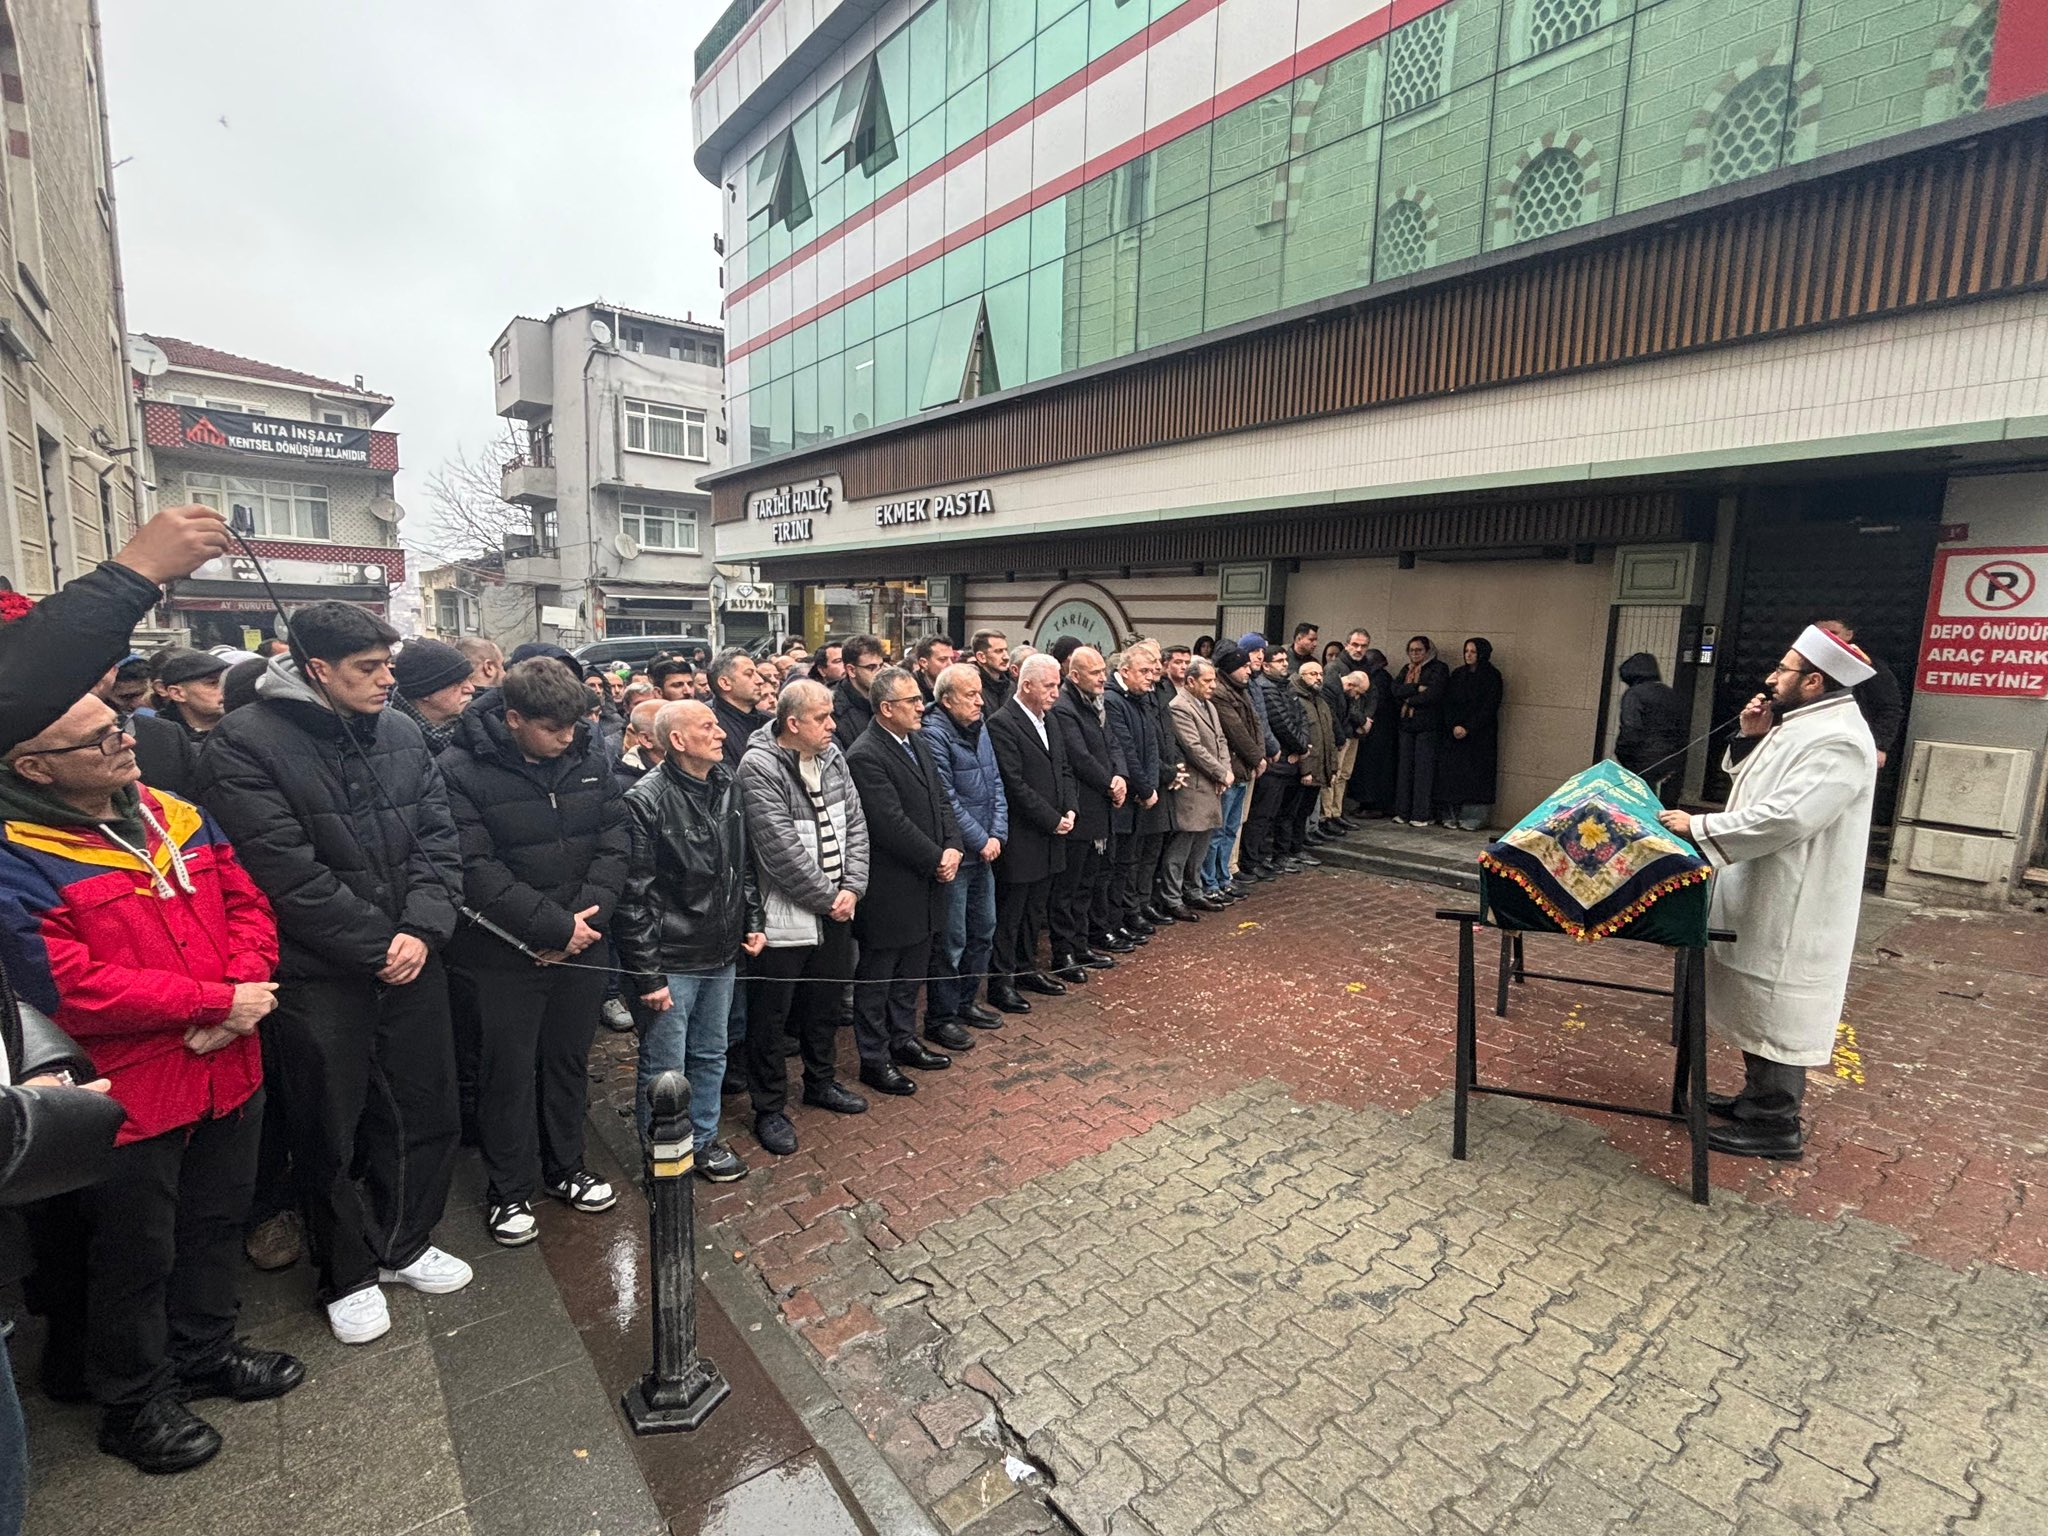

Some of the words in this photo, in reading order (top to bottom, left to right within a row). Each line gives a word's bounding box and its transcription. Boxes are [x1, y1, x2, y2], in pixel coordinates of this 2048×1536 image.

[252, 422, 286, 437] KITA
[291, 425, 344, 444] İNŞAAT
[228, 436, 274, 452] KENTSEL
[276, 441, 323, 458] DÖNÜŞÜM
[325, 448, 367, 462] ALANIDIR
[753, 487, 791, 519] TARİHİ
[793, 479, 831, 514] HALİÇ
[875, 499, 930, 527] EKMEK
[934, 489, 993, 518] PASTA
[772, 518, 812, 543] FIRINI
[238, 601, 285, 611] KURUYE
[1054, 612, 1095, 633] TARİHİ
[1930, 624, 1975, 640] DEPO
[1927, 648, 1985, 666] ARAÇ
[1991, 650, 2048, 665] PARK
[1926, 671, 2045, 690] ETMEYİNİZ
